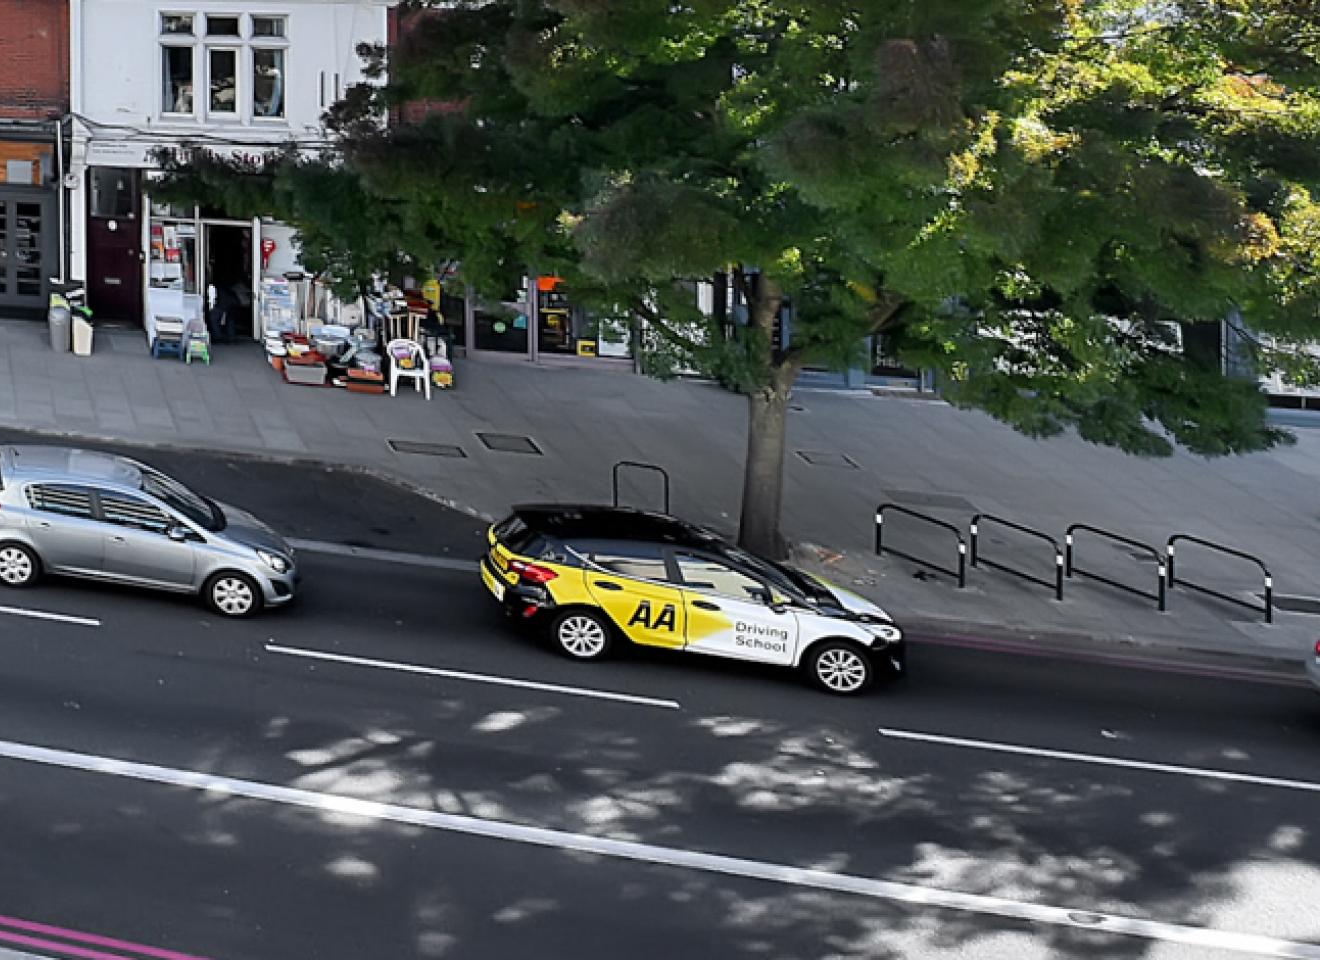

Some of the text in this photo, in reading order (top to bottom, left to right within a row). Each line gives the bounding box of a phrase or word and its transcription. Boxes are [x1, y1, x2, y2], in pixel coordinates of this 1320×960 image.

[627, 600, 676, 632] AA
[735, 621, 788, 640] Driving
[735, 635, 787, 653] School
